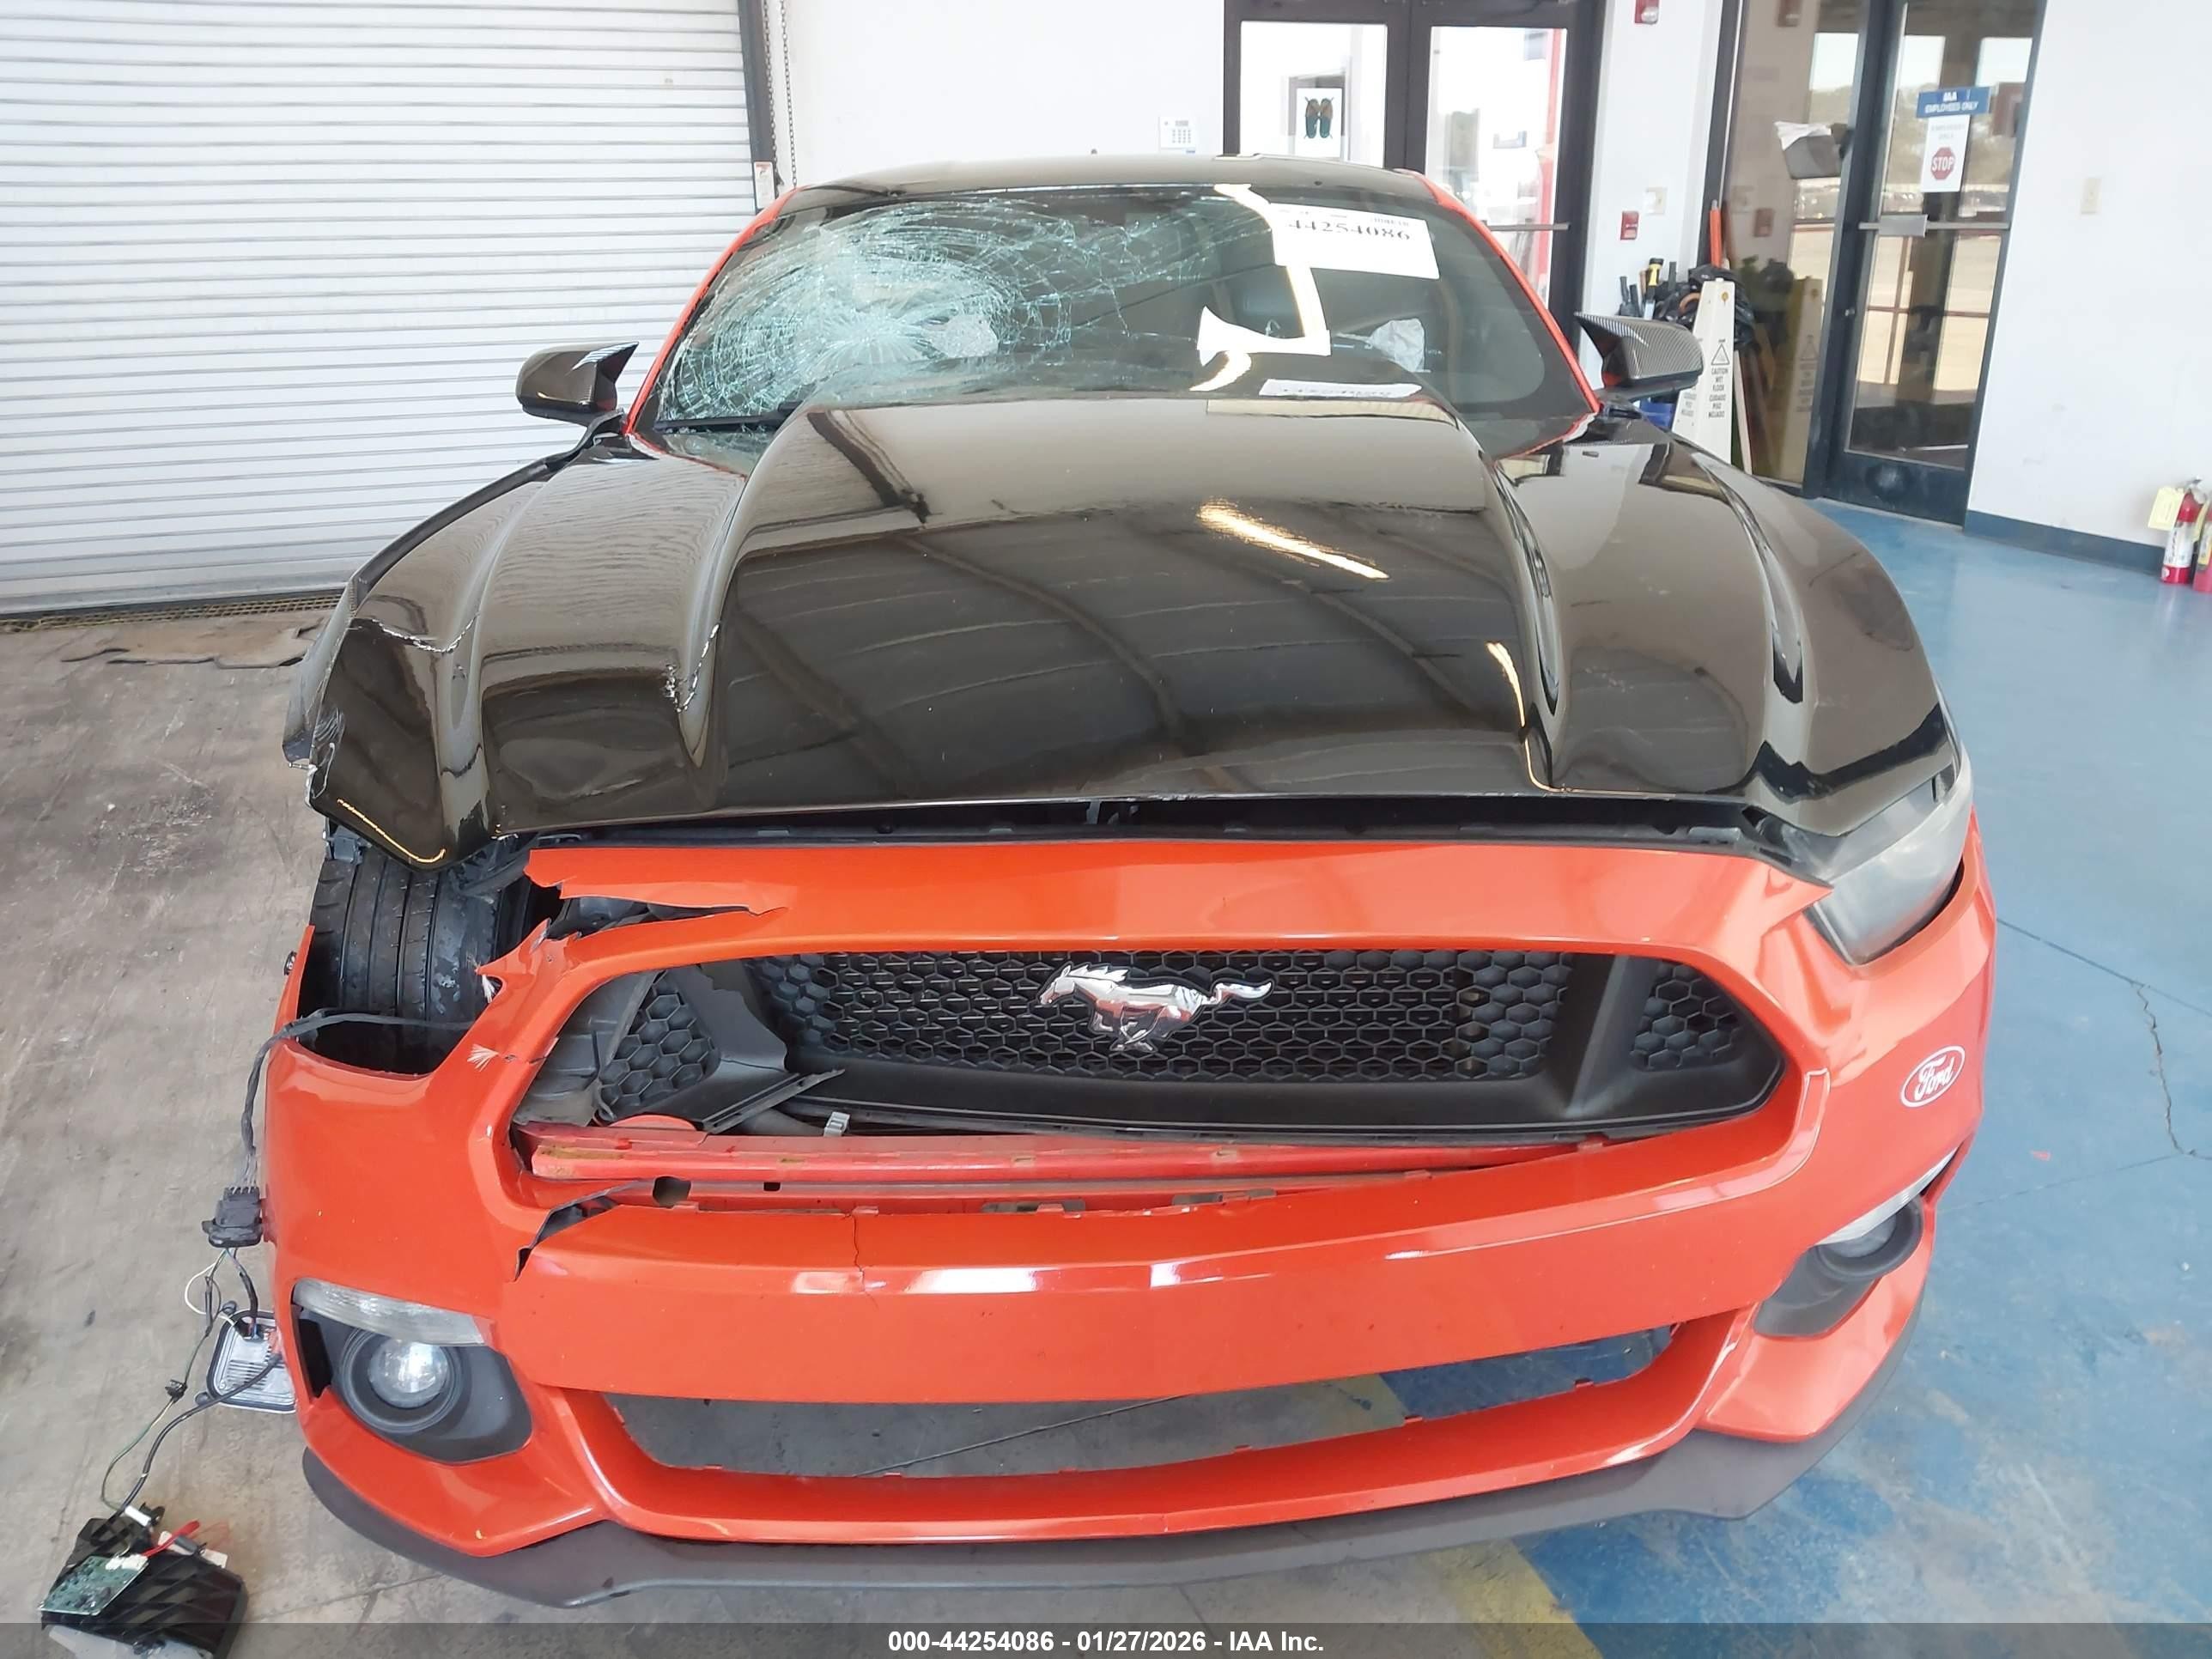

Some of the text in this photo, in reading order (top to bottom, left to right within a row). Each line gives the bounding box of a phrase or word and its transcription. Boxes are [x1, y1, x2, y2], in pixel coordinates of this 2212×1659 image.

[1961, 101, 1978, 111] ONLY
[1932, 156, 1955, 172] STOP
[1289, 220, 1410, 240] 44254086
[1914, 1054, 1955, 1101] Ford
